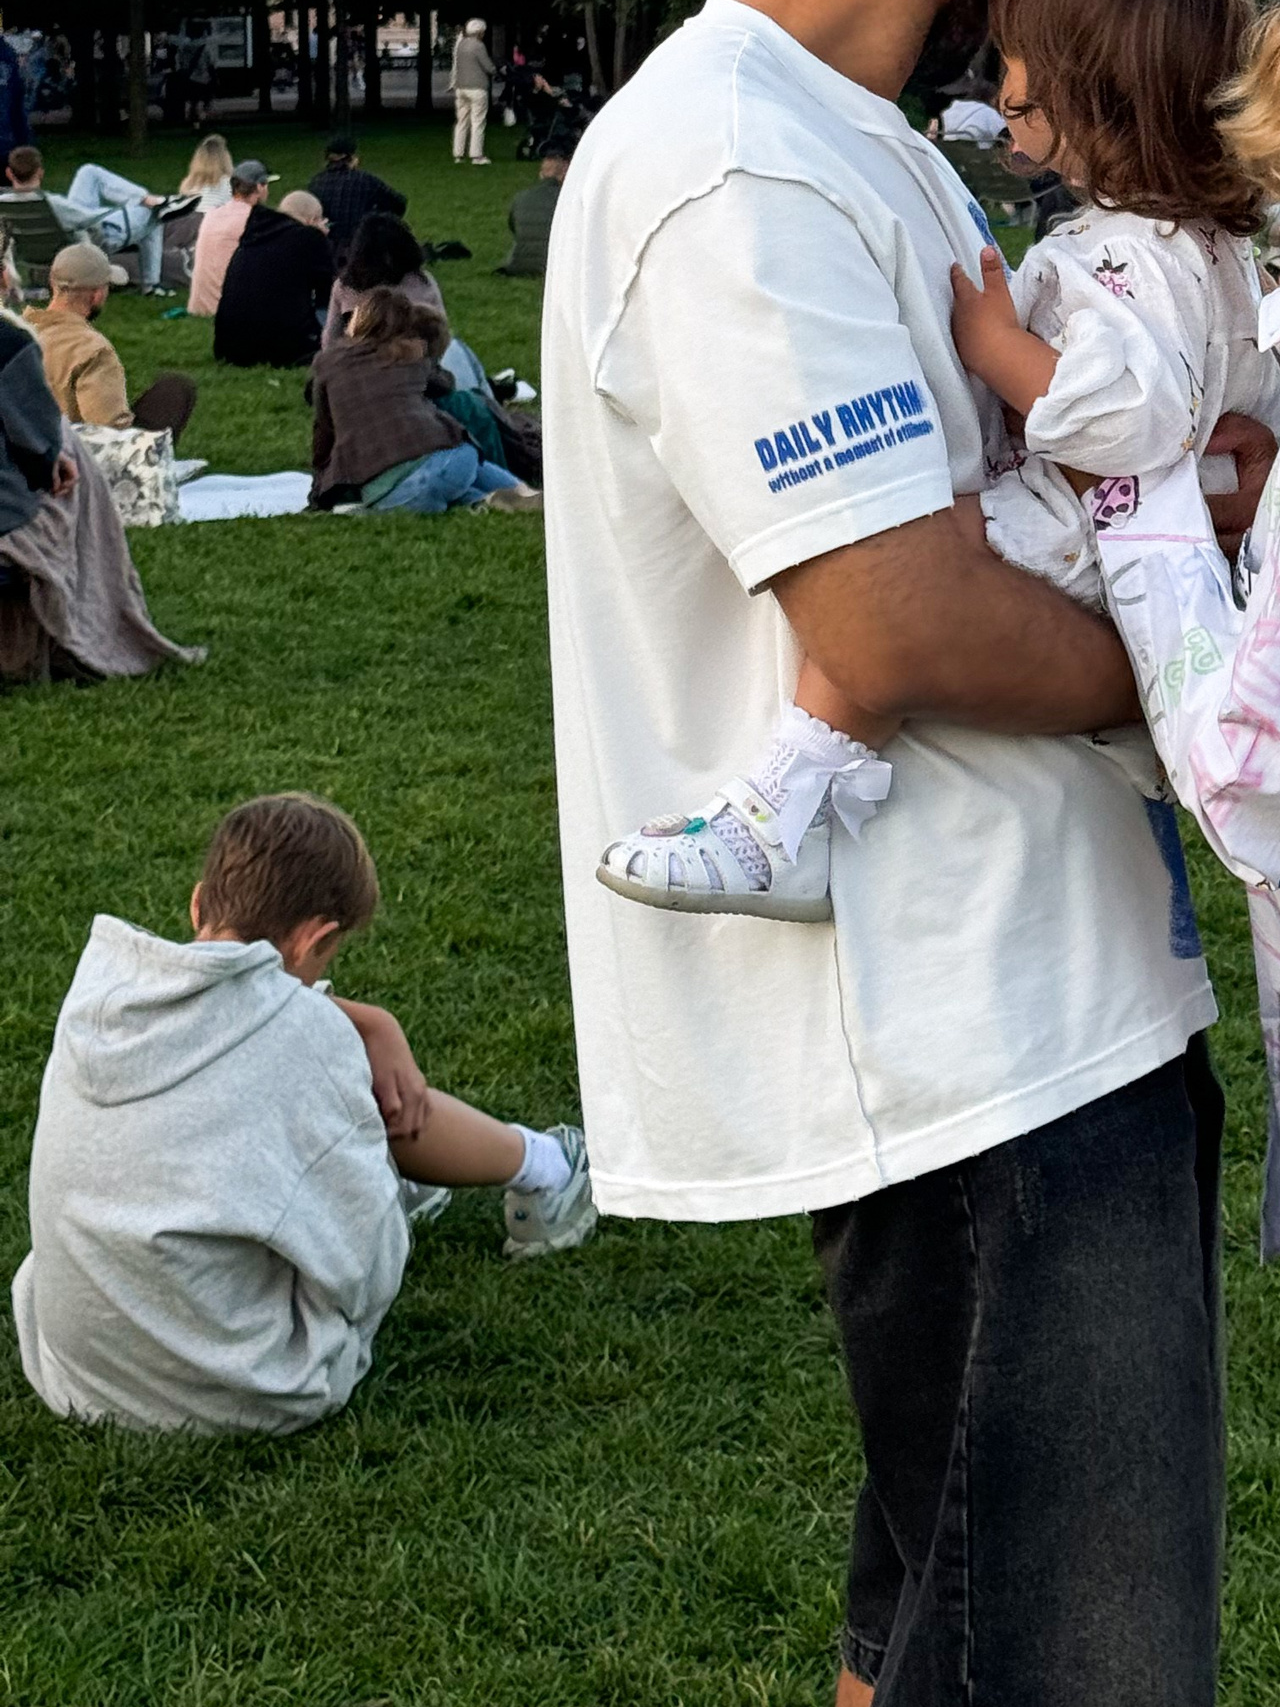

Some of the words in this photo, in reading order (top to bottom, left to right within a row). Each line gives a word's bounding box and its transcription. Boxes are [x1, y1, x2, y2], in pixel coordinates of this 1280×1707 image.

[754, 409, 836, 472] DAILY
[768, 461, 824, 493] without
[824, 454, 834, 472] a
[834, 435, 885, 470] moment
[883, 427, 896, 449] of
